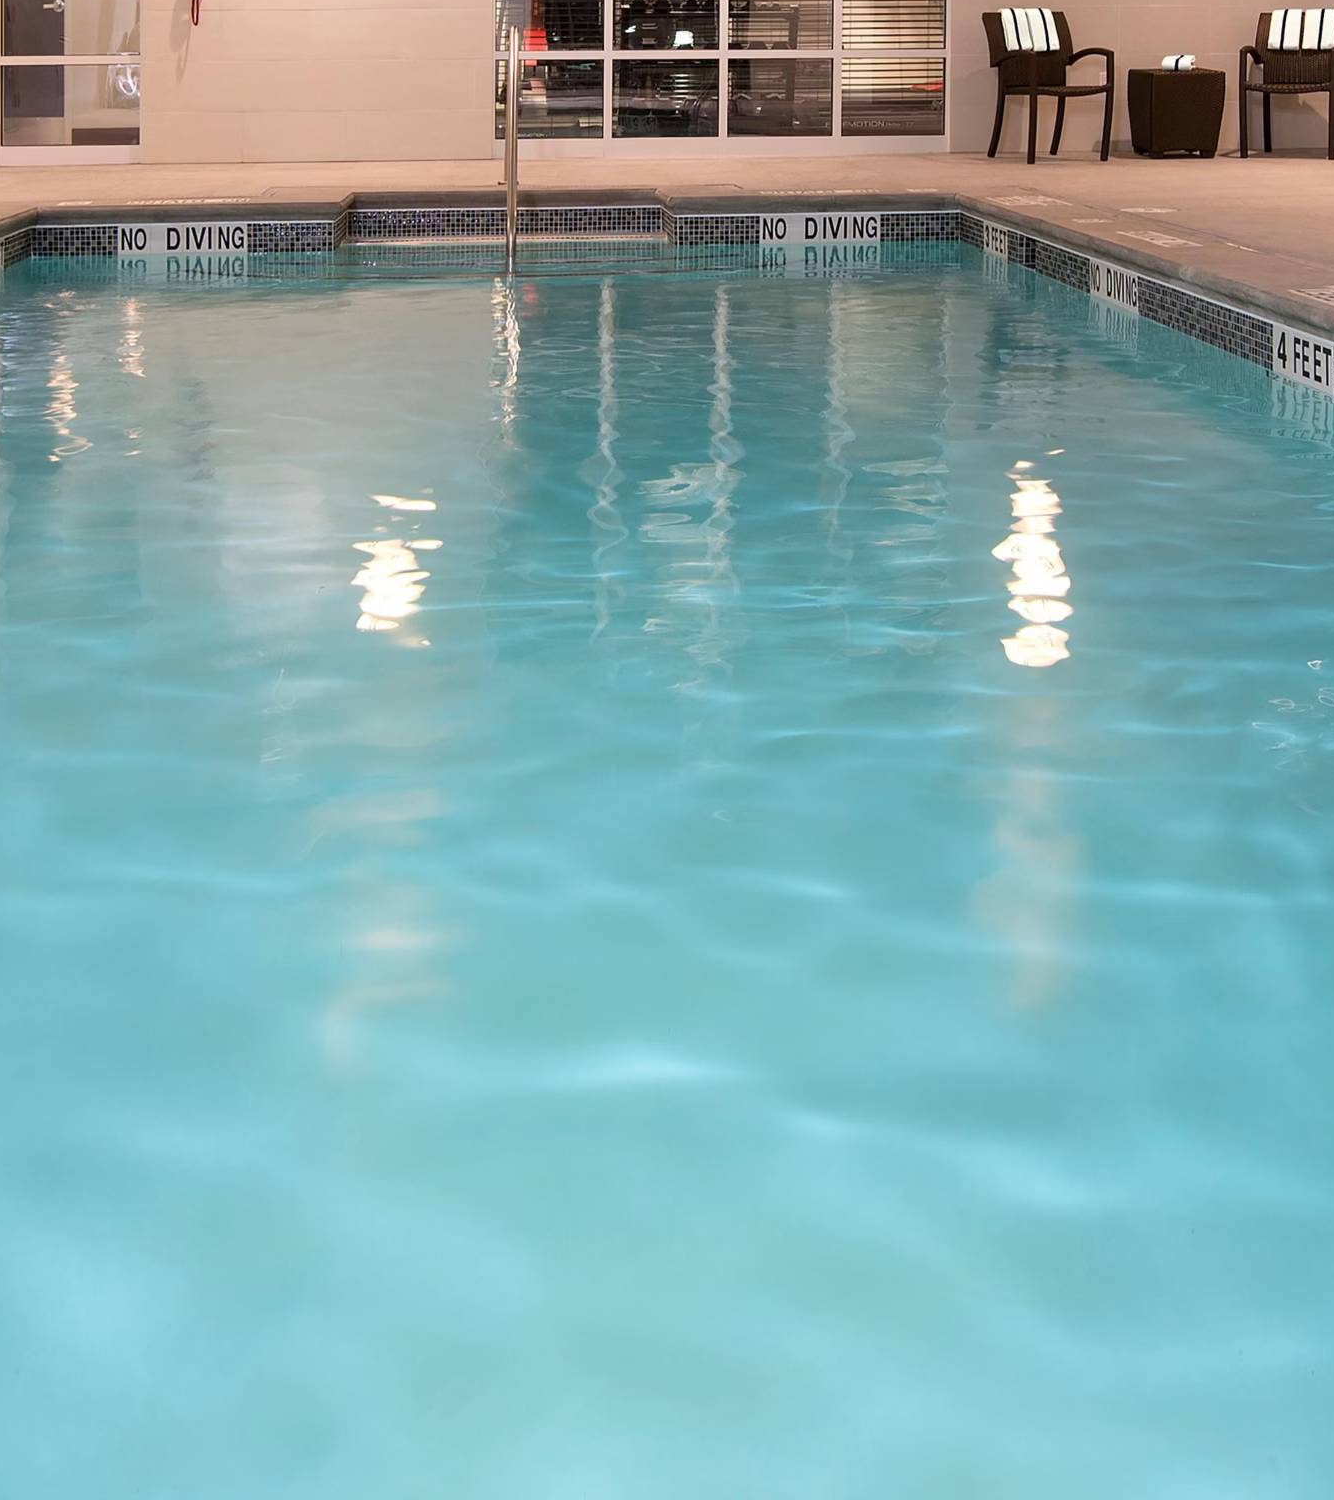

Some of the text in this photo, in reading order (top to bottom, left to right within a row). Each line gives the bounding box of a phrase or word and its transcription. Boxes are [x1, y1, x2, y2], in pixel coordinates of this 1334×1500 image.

[121, 226, 244, 250] NO DIVING
[762, 216, 878, 240] NO DIVING
[985, 225, 1006, 255] 3 FEET
[1090, 262, 1137, 307] NO DIVING
[1278, 331, 1332, 386] 4 FEET
